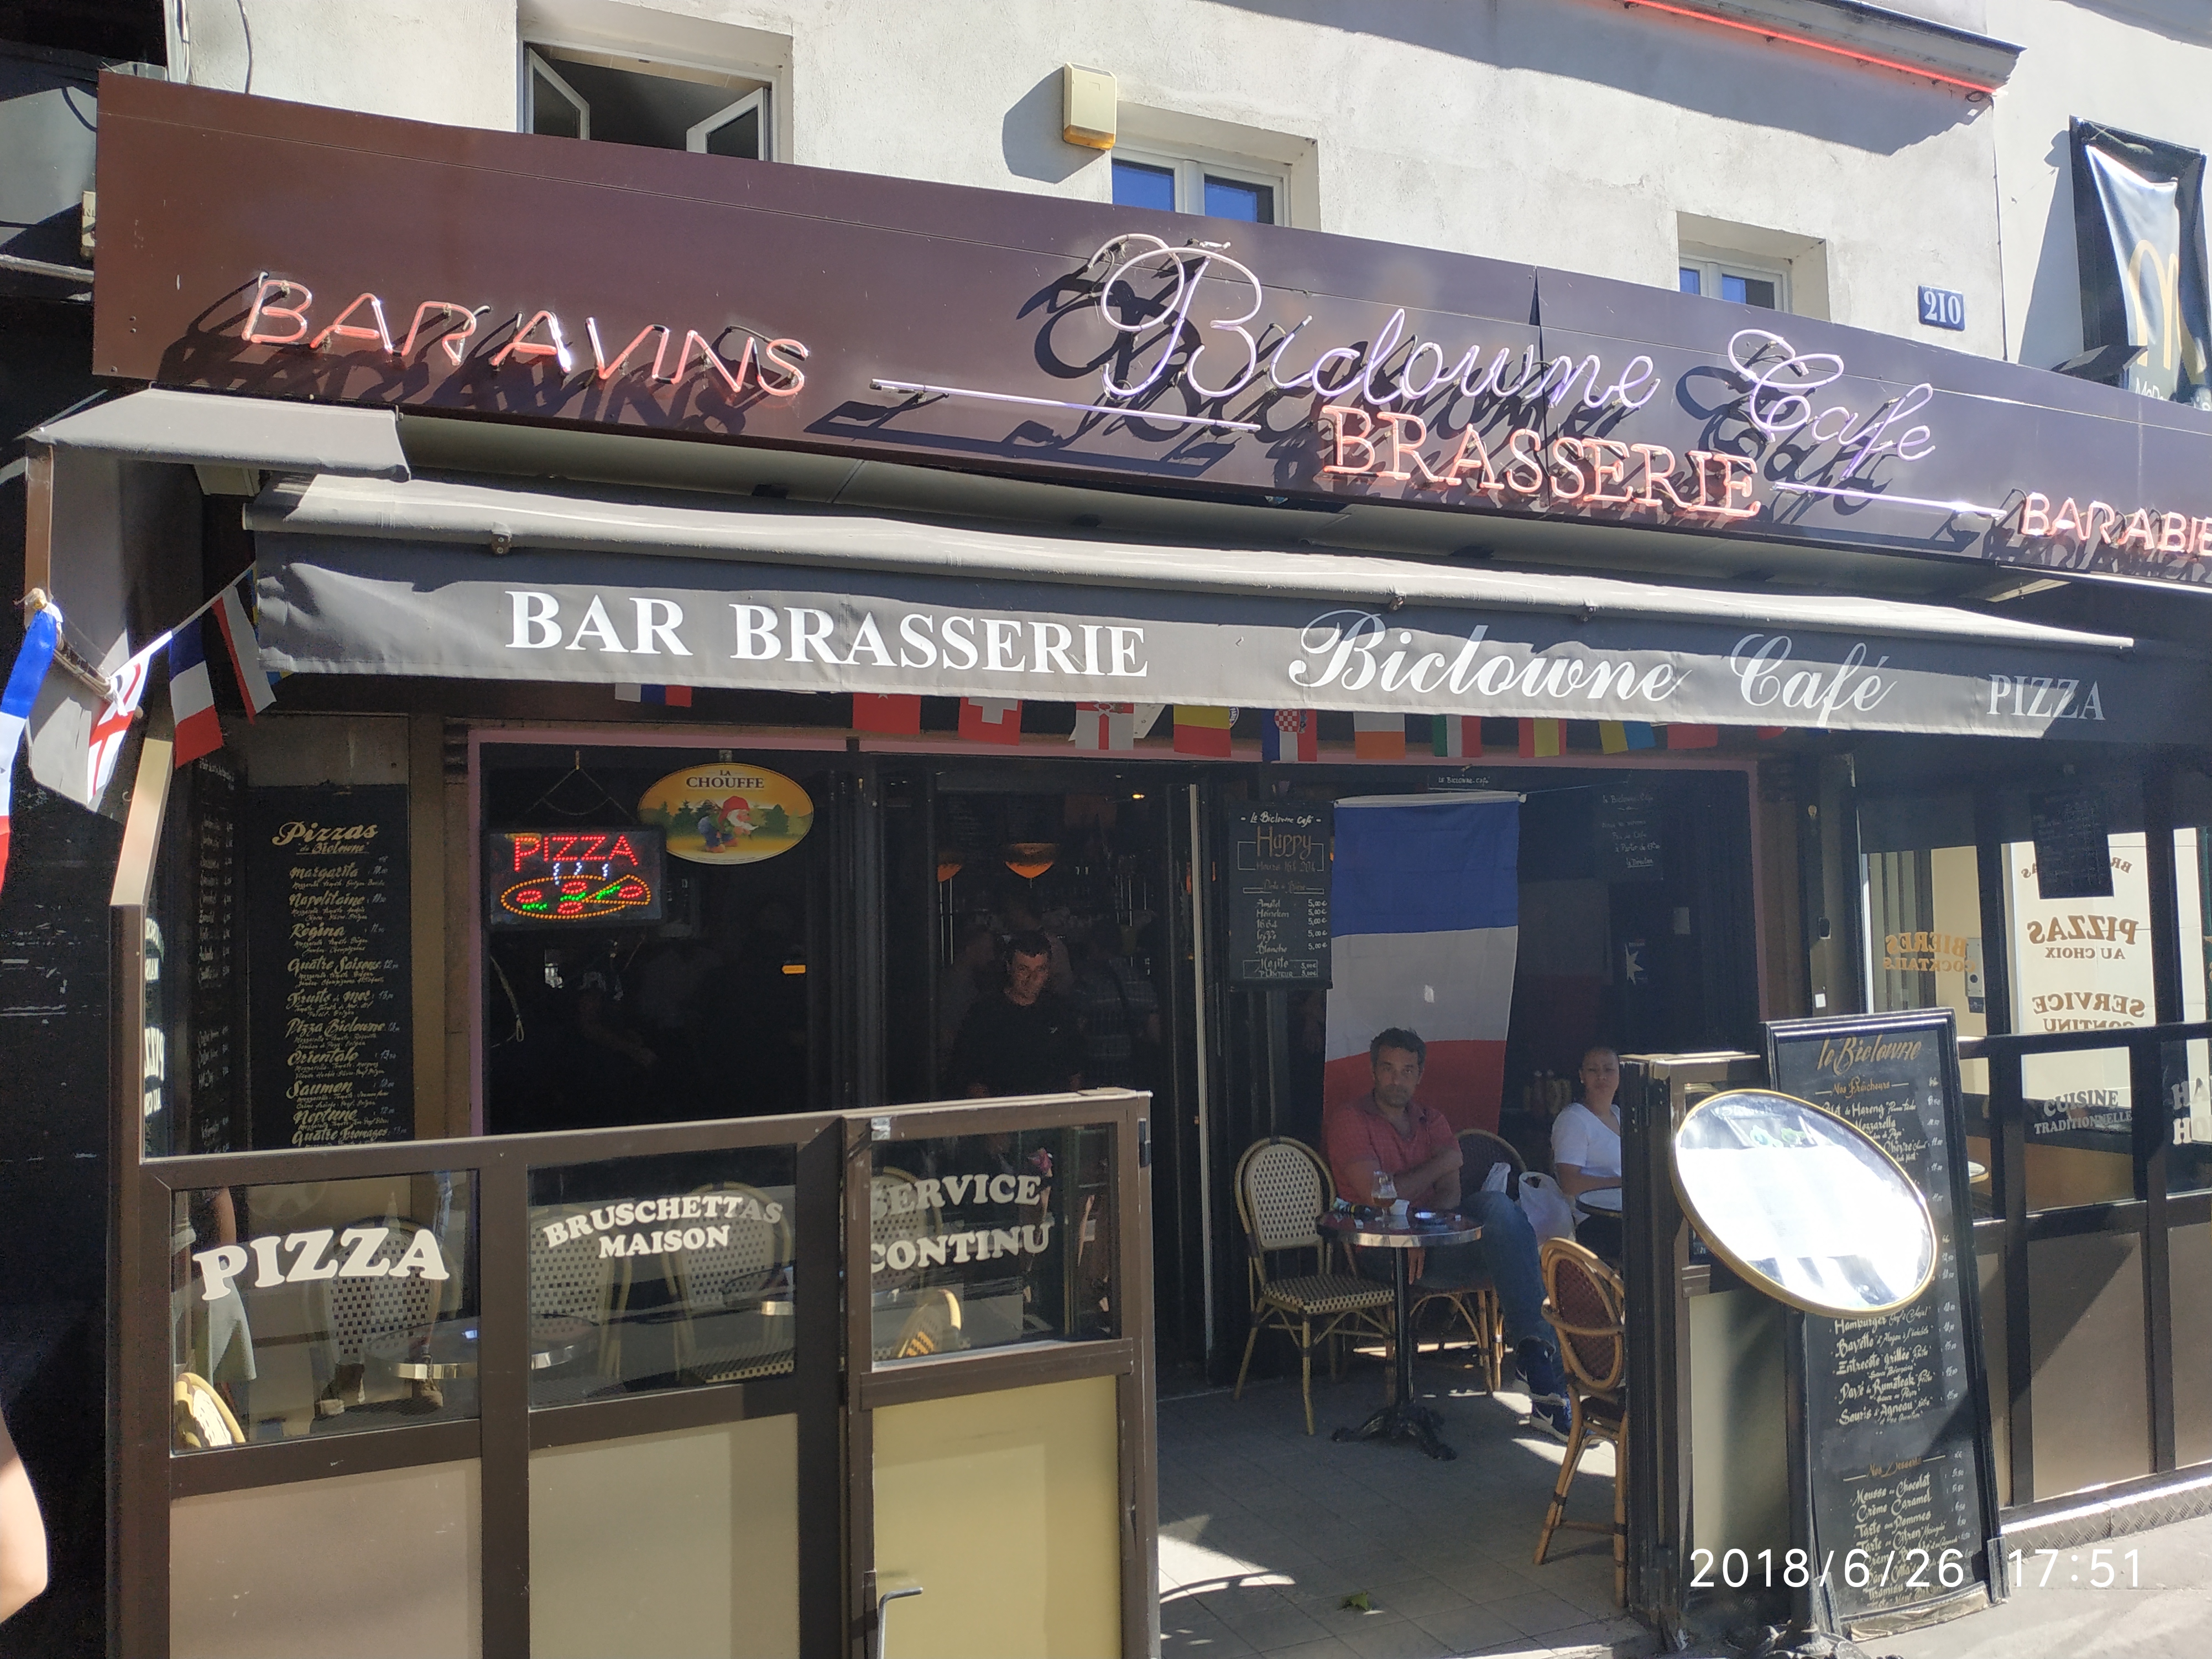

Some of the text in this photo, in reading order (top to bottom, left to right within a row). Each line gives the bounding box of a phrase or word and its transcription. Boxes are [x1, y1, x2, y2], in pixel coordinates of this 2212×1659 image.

[1924, 291, 1961, 325] 210
[1322, 405, 1761, 518] BRASSERIE
[504, 589, 2106, 727] BAR BRASSERIE Biclowne Café PIZZA
[685, 776, 765, 789] CHOUFFE
[272, 821, 379, 846] Pizzas
[1256, 825, 1312, 860] Happy
[514, 835, 639, 872] PIZZA
[285, 1017, 324, 1039] Pizza
[2043, 1089, 2119, 1117] CUISINE
[2034, 1110, 2133, 1135] TRADITIONNELLE
[870, 1173, 1042, 1220] SERVICE
[542, 1195, 784, 1248] BRUSCHETTAS
[598, 1224, 730, 1259] MAISON
[870, 1223, 1054, 1274] CONTINU
[192, 1227, 450, 1301] PIZZA
[1834, 1315, 1887, 1335] Hamburger
